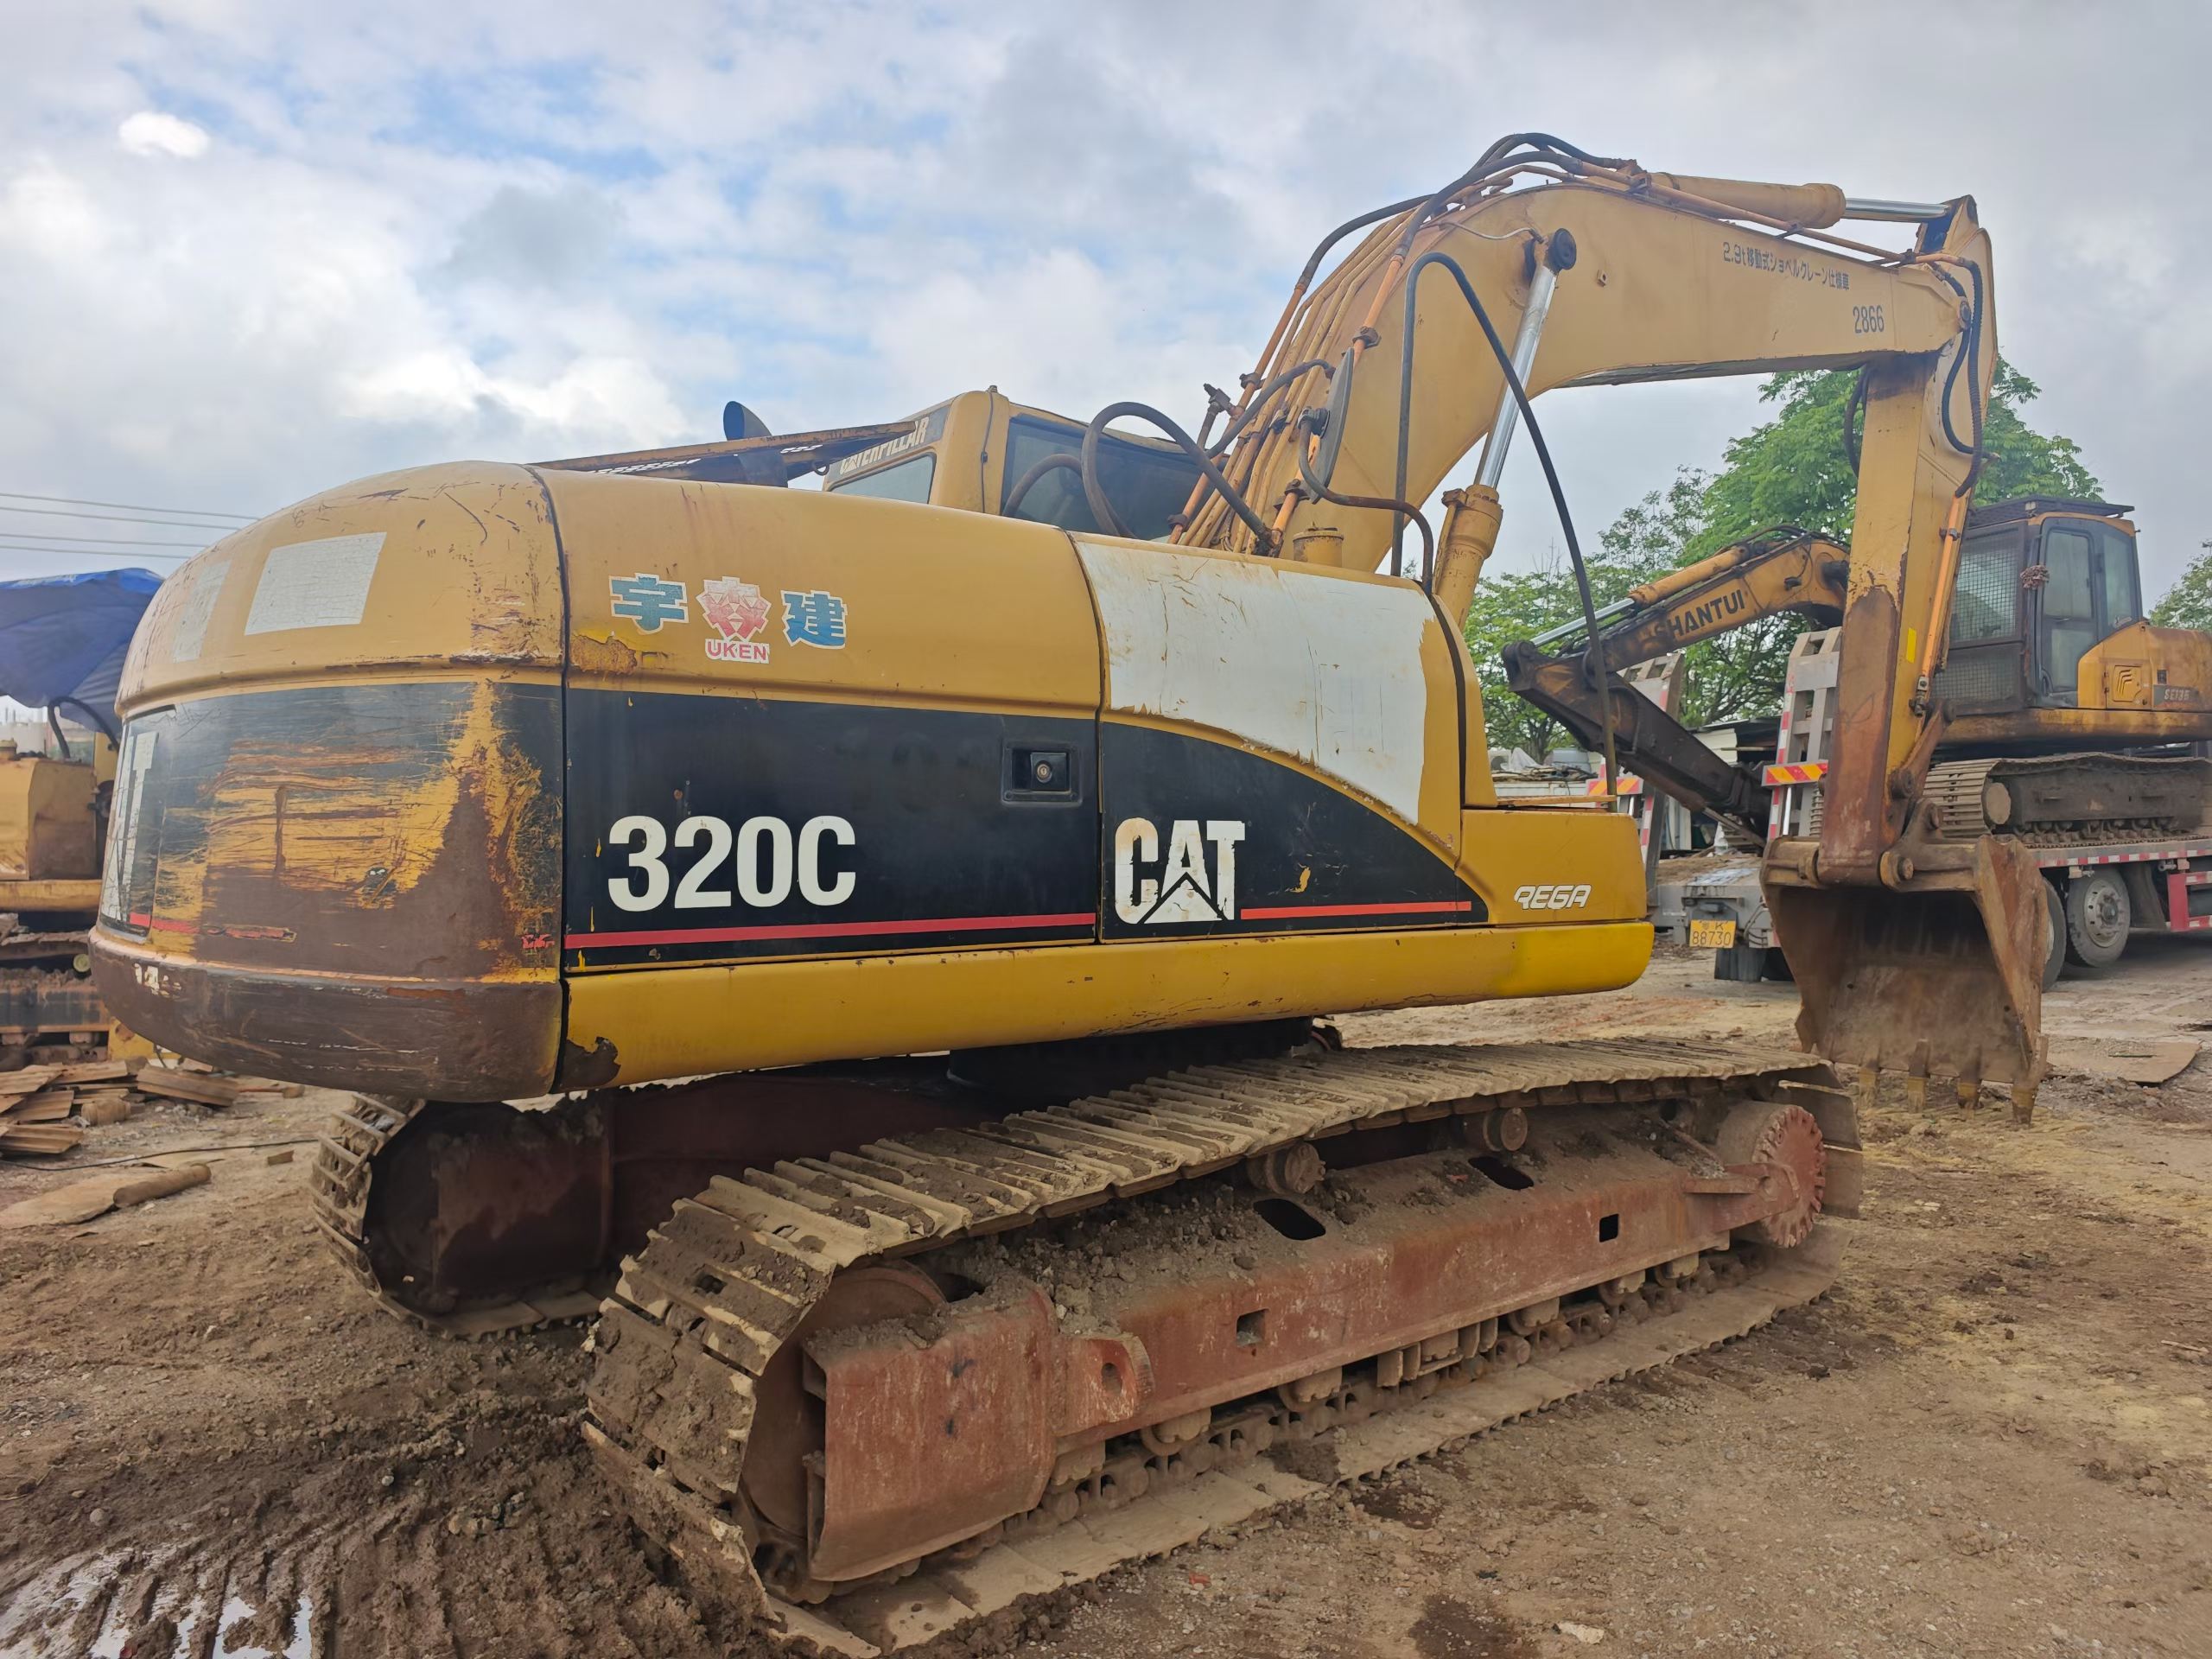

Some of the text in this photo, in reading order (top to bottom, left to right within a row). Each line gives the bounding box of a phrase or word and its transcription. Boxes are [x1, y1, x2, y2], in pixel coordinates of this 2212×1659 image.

[1853, 304, 1885, 334] 2866
[608, 574, 846, 648] 宇 建
[707, 640, 766, 662] UKEN
[607, 815, 856, 912] 320C
[1114, 817, 1246, 925] CAT
[1514, 884, 1592, 911] REGA
[1693, 931, 1732, 946] 88730
